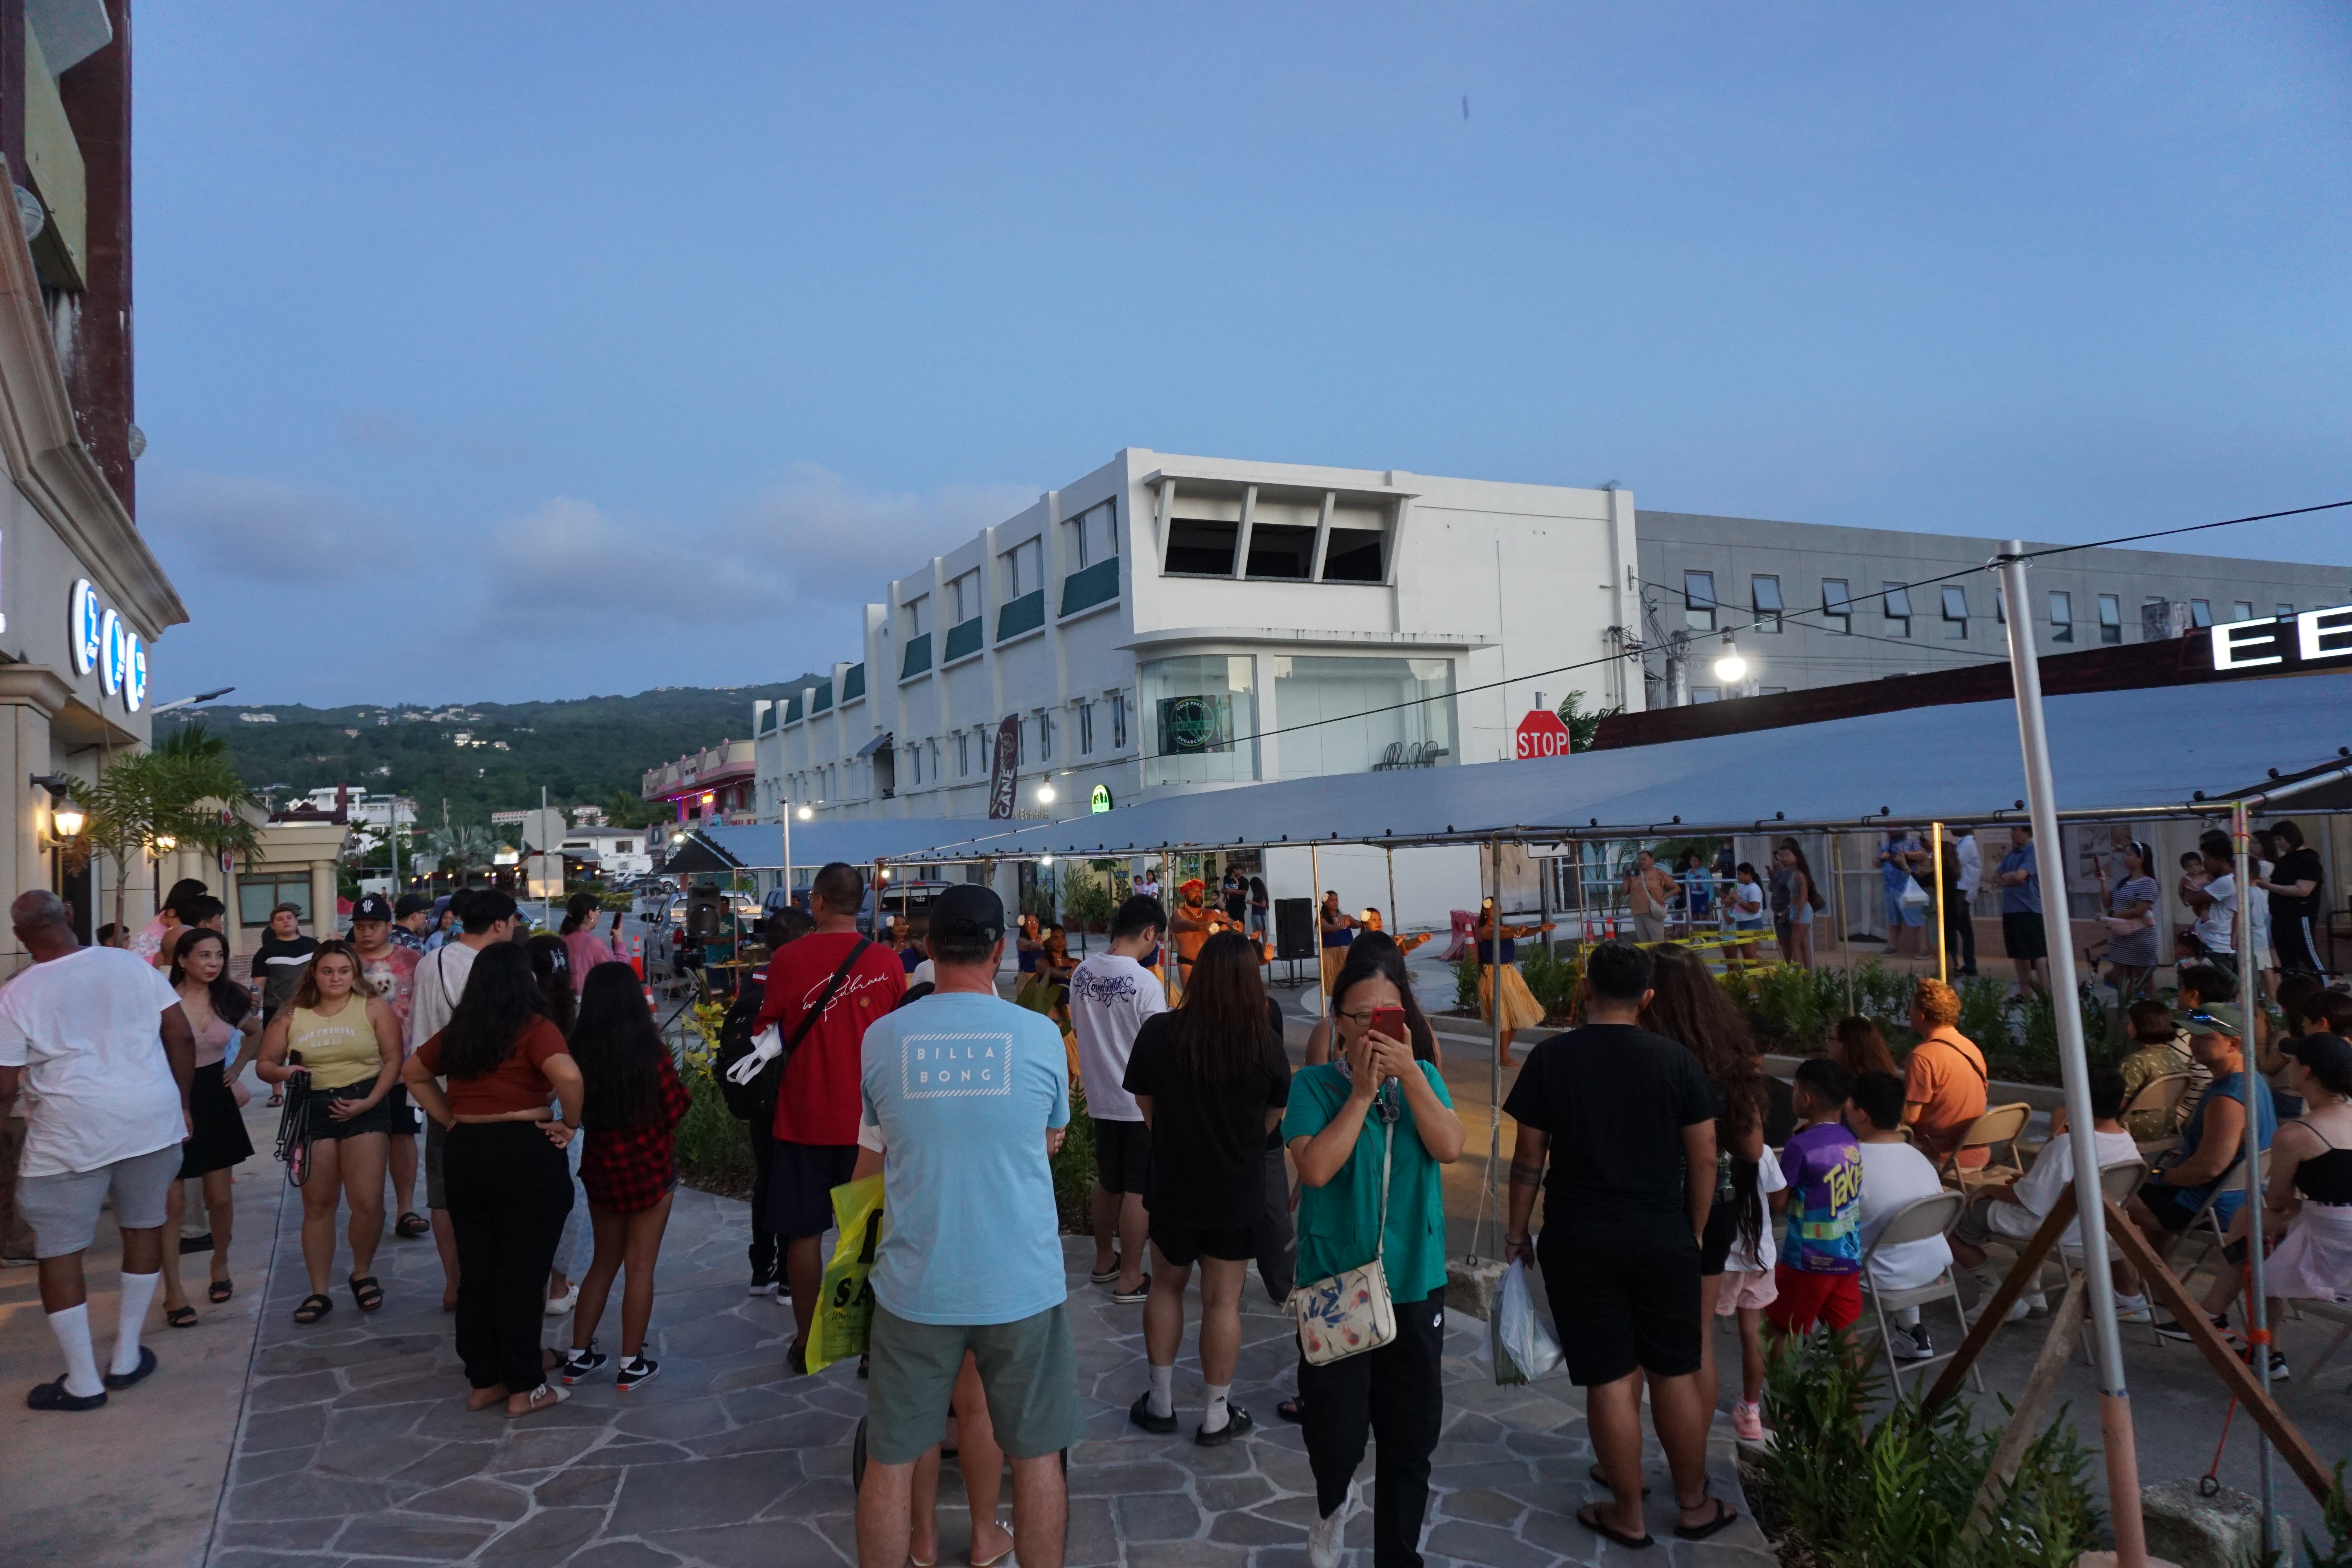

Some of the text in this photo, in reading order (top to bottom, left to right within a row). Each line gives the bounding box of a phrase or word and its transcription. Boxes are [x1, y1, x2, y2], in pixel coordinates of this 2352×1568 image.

[1177, 702, 1189, 710] COLD
[1177, 735, 1207, 744] SUGARCANE
[1518, 731, 1568, 757] STOP
[999, 768, 1014, 819] CANE
[1011, 809, 1020, 819] eal
[1021, 808, 1039, 819] Estate
[298, 1027, 356, 1044] NORTHSHORE
[310, 1038, 342, 1048] HAWAII
[917, 1046, 995, 1060] BILLA
[920, 1069, 991, 1083] BONG
[833, 1277, 873, 1308] SA
